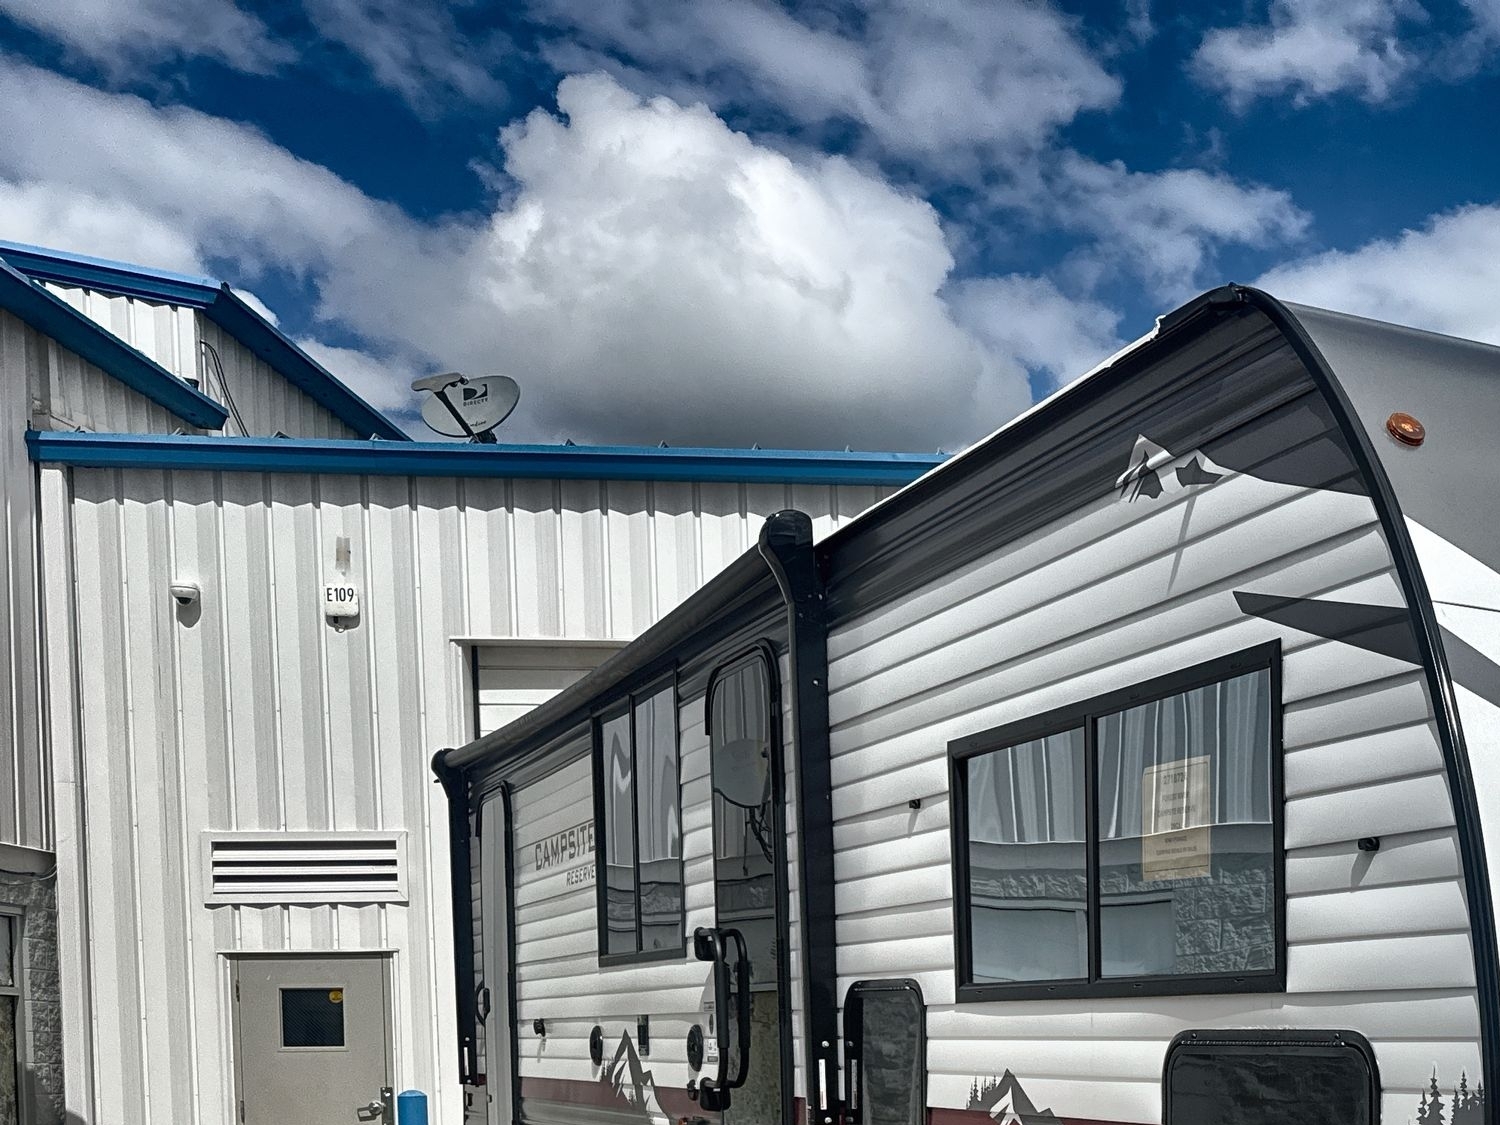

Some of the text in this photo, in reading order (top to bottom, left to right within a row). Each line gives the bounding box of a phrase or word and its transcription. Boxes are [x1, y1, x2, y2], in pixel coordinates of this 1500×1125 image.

[326, 587, 354, 602] E109
[535, 822, 596, 871] CAMPSITE
[566, 864, 595, 886] RESERVE
